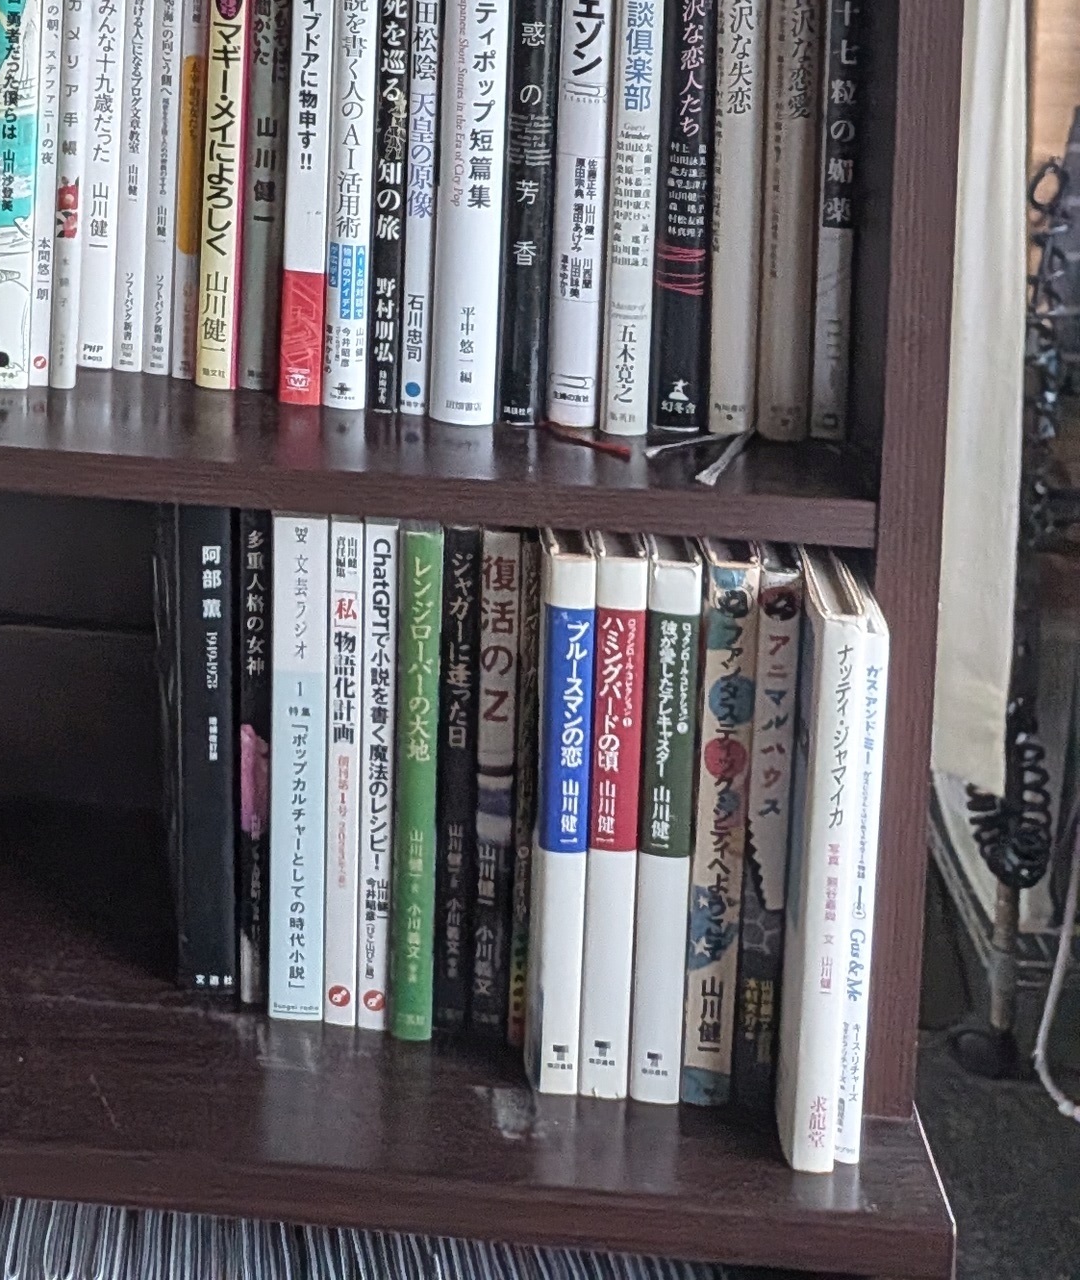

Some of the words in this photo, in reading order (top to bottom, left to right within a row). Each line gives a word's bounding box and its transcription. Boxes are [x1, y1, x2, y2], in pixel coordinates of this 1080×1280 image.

[206, 21, 241, 257] マギー・メイによろしく
[376, 158, 400, 240] 知の旅
[407, 92, 434, 218] 天皇の原像
[88, 183, 108, 249] 山川健一
[406, 294, 423, 362] 石川忠司
[614, 325, 636, 404] 五木寛之
[246, 530, 264, 676] 多重人格の女神
[408, 557, 431, 761] レンジローバーの大地
[481, 556, 516, 722] 復活のZ
[560, 620, 589, 768] ブルースマンの恋
[598, 616, 623, 772] ハミングバードの頃
[829, 645, 853, 828] ナッティ・ジャマイカ
